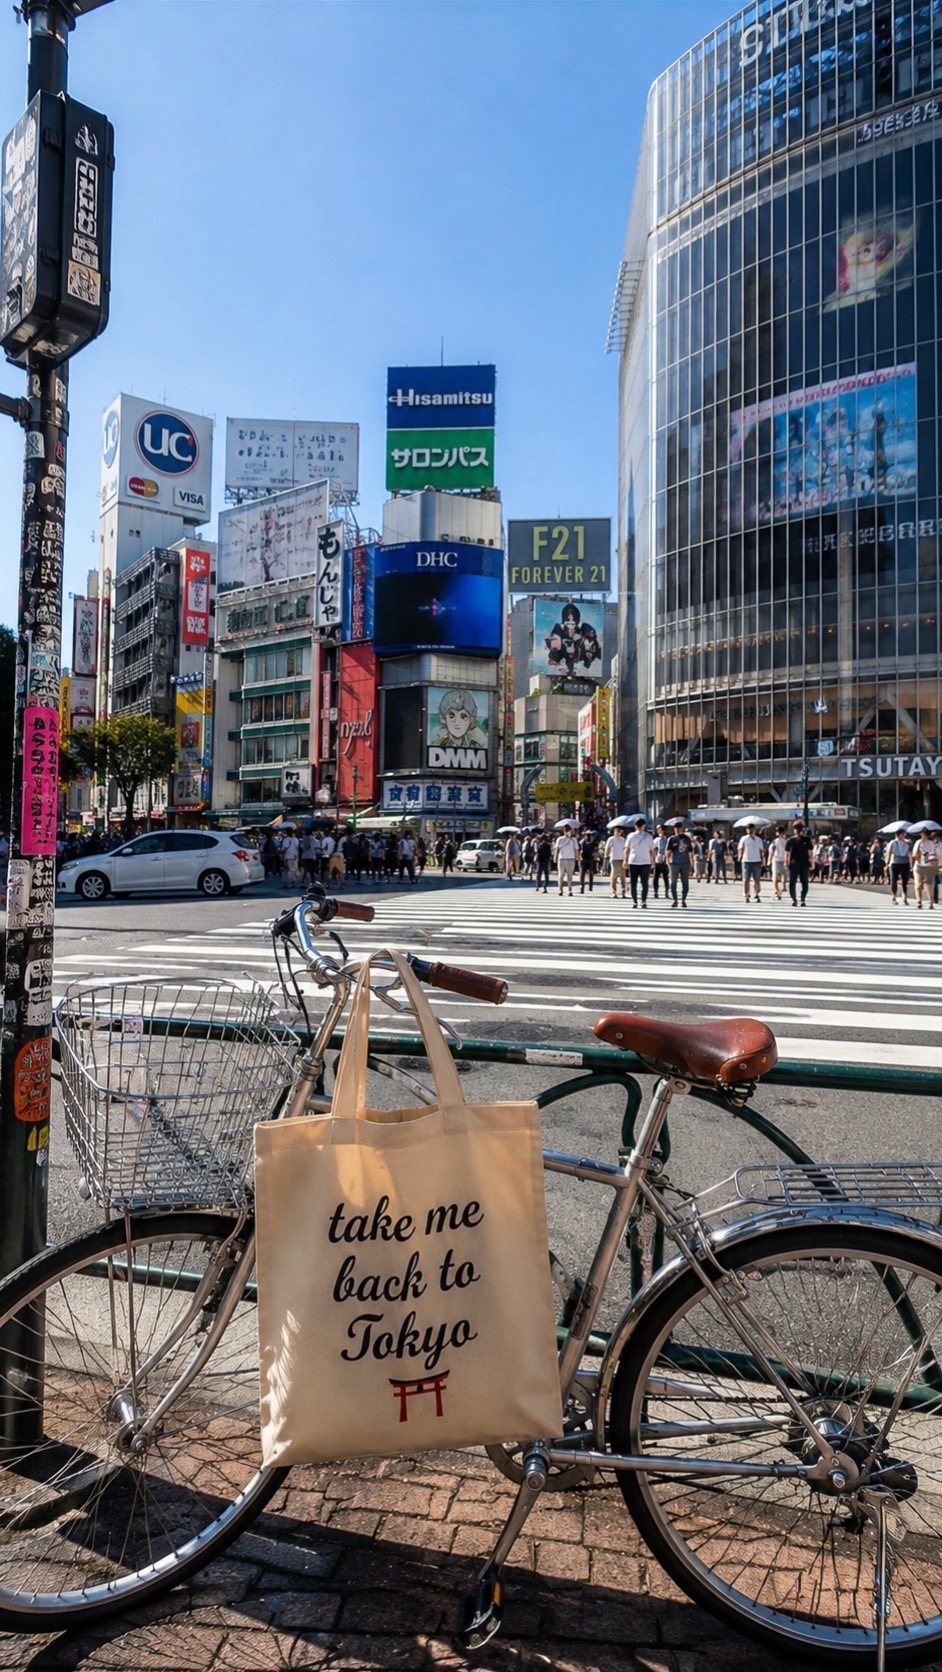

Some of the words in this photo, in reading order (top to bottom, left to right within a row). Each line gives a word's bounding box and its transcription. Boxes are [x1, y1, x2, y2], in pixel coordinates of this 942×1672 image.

[388, 389, 493, 407] Hisamitsu
[143, 422, 193, 462] UC
[391, 446, 489, 468] サロンパス
[178, 490, 204, 506] VISA
[533, 525, 585, 561] F21
[416, 551, 458, 568] DHC
[317, 527, 341, 622] もんじゃ
[511, 566, 584, 584] FOREVER
[590, 565, 607, 583] 21
[428, 747, 487, 769] DMM
[841, 756, 942, 778] TSUTAY
[328, 1195, 416, 1244] take
[424, 1200, 485, 1236] me
[332, 1251, 428, 1303] back
[439, 1248, 481, 1292] to
[340, 1310, 479, 1371] Tokyo
